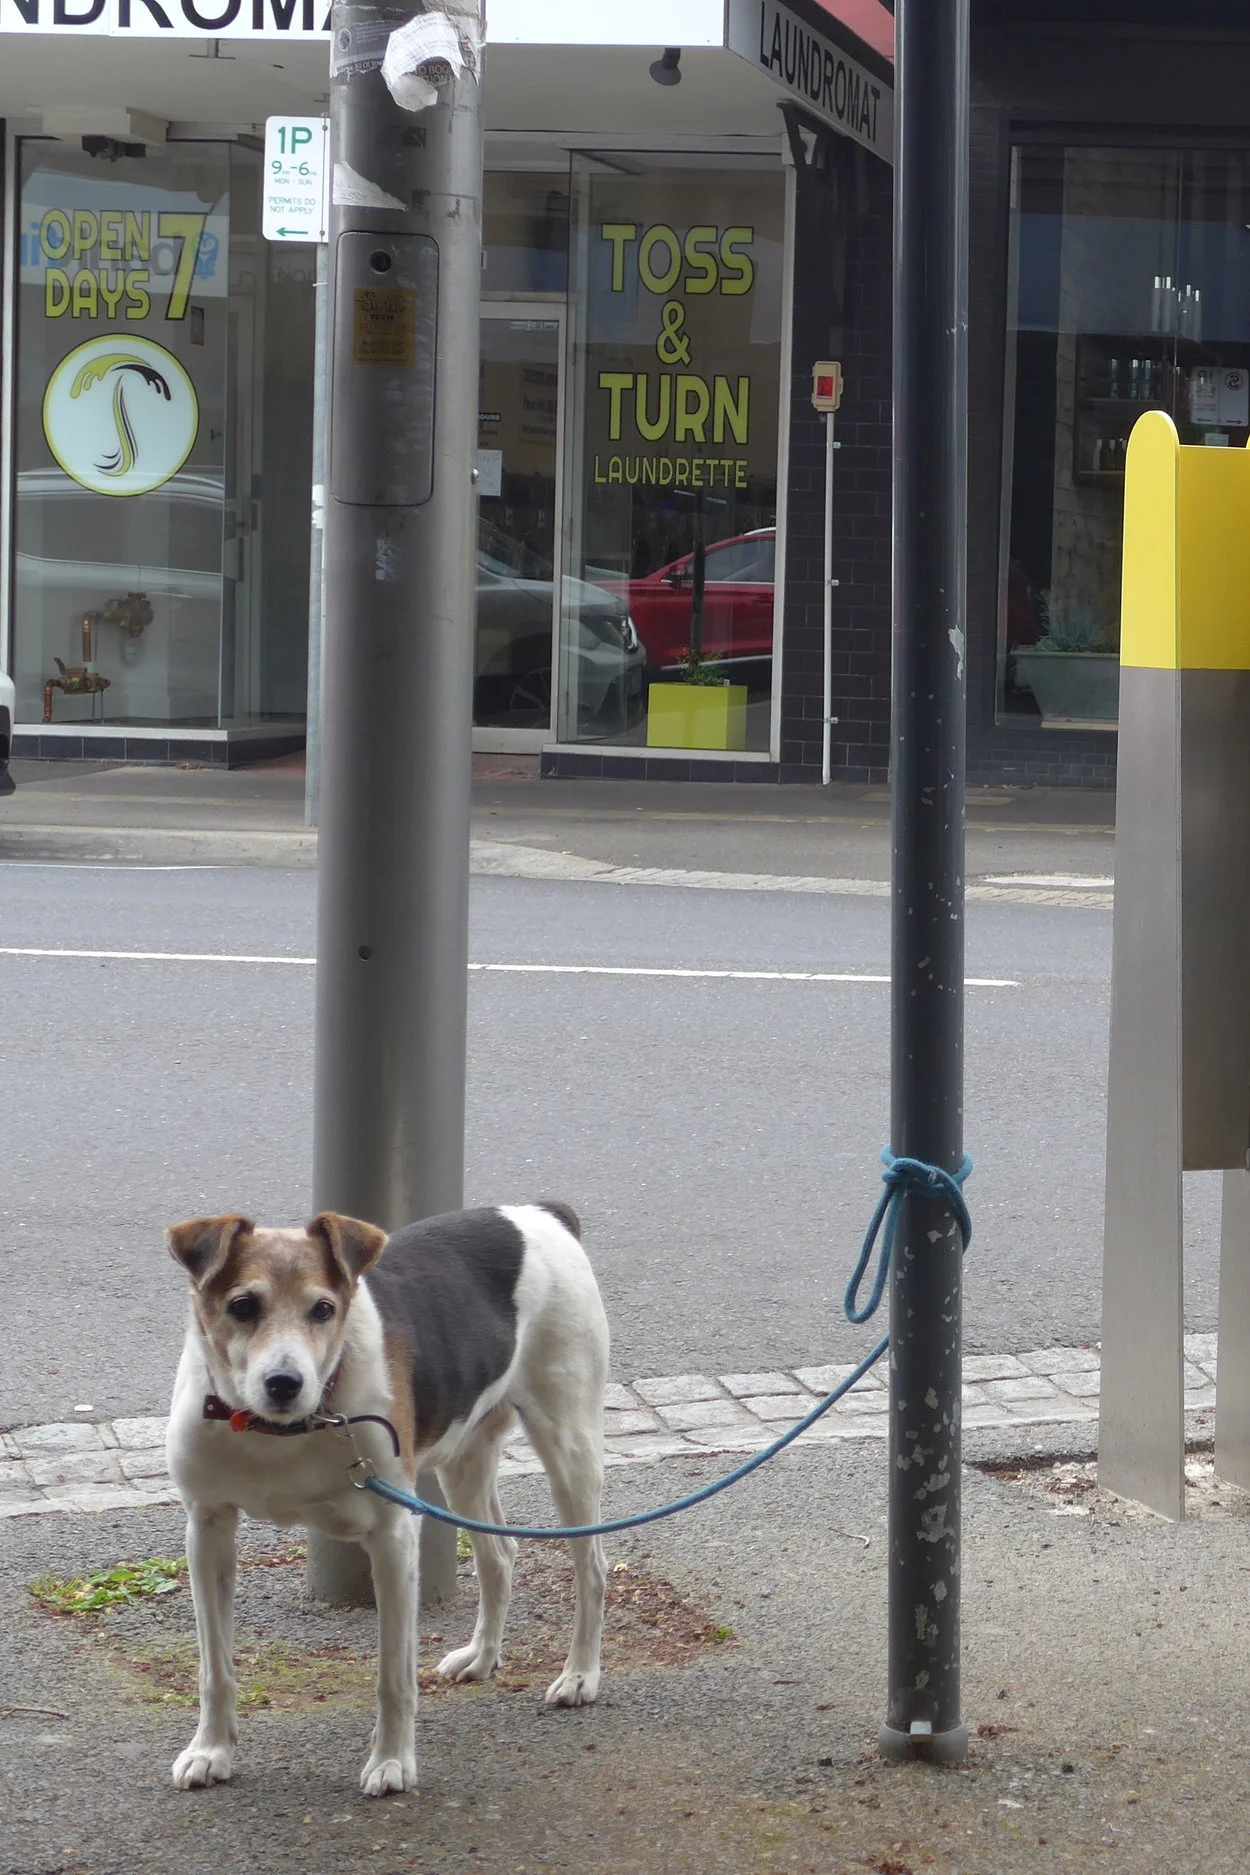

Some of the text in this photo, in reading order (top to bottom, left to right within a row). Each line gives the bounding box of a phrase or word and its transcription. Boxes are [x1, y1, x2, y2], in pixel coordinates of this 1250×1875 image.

[760, 1, 882, 143] LAUNDROMAT
[278, 126, 313, 154] 1P
[268, 196, 316, 206] PERMITS DO
[288, 207, 313, 215] APPLY
[40, 208, 151, 261] OPEN
[157, 211, 209, 321] 7
[601, 223, 754, 295] TOSS
[45, 267, 151, 320] DAYS
[657, 299, 691, 367] &
[598, 371, 750, 444] TURN
[594, 456, 748, 488] LAUNDRETTE
